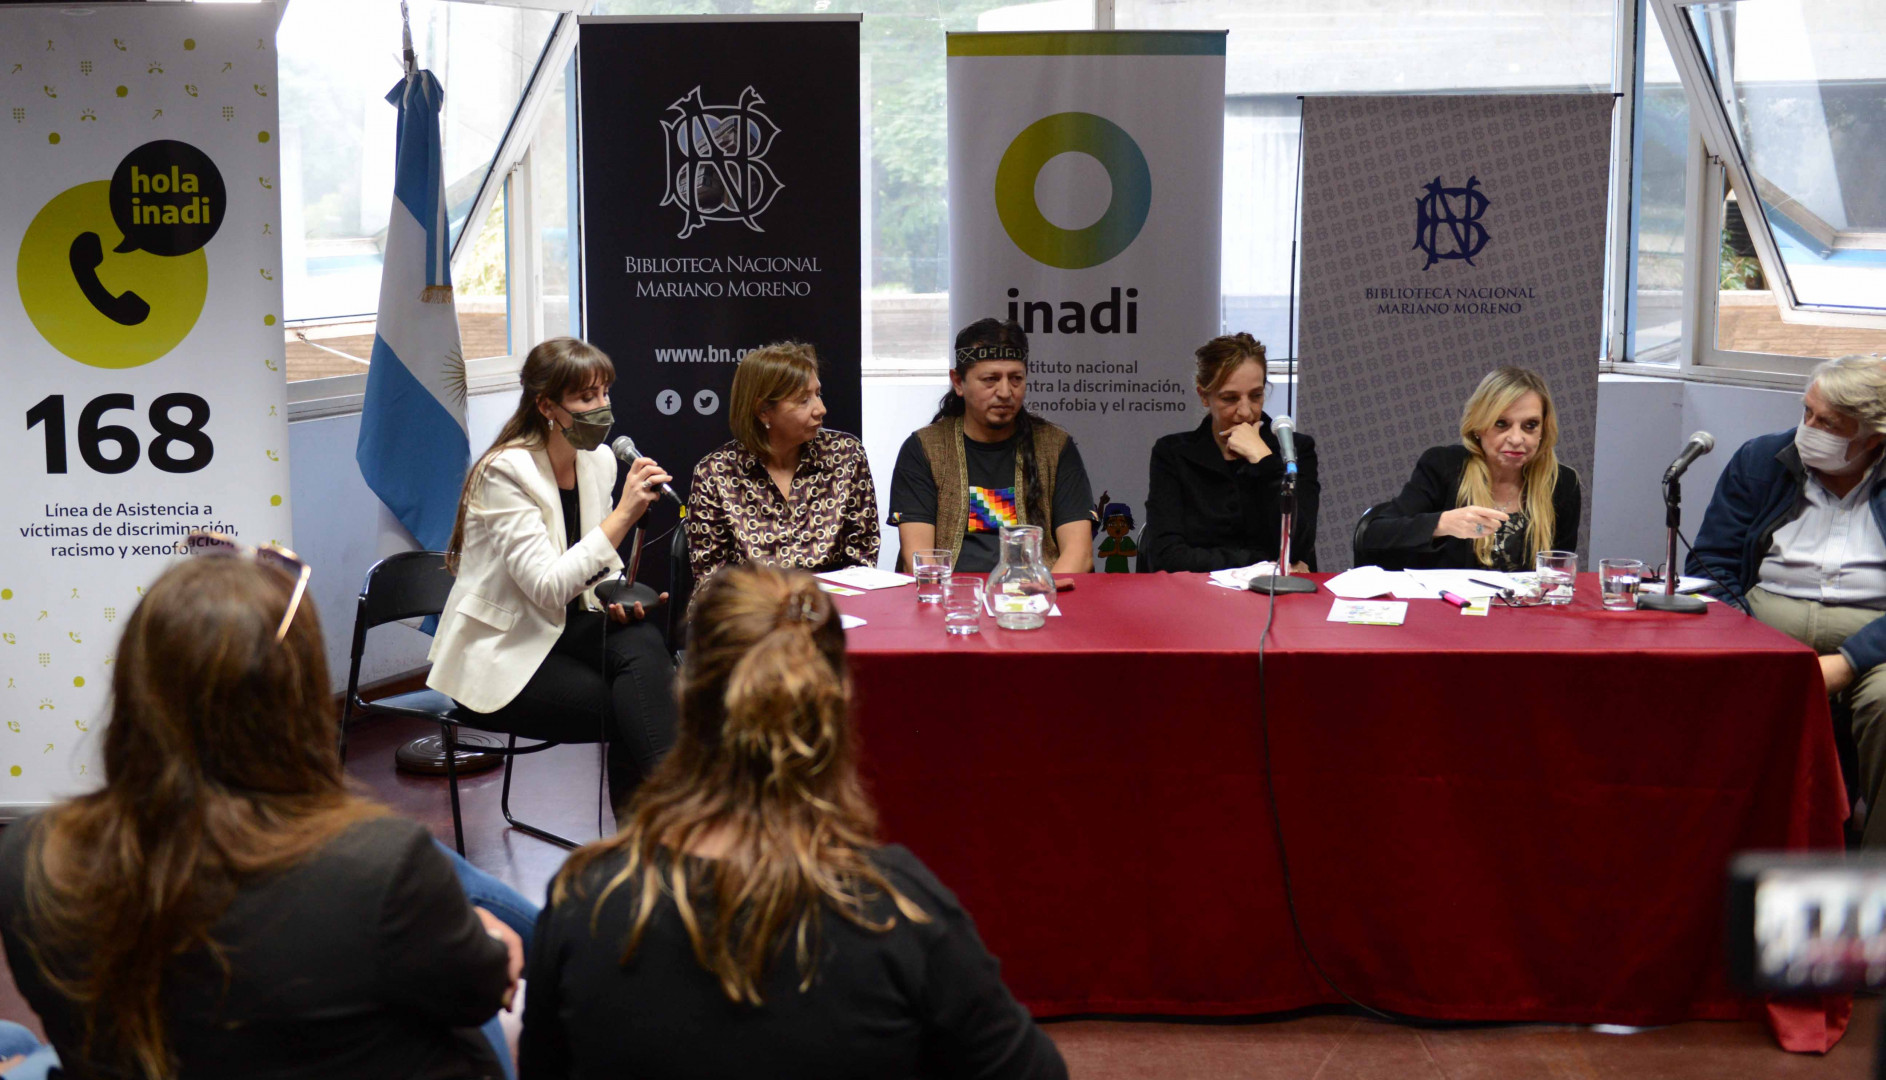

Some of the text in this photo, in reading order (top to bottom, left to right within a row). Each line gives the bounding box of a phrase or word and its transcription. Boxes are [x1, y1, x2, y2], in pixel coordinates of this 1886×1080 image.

[131, 165, 199, 193] hola
[132, 197, 210, 224] inadi
[1366, 287, 1536, 299] BIBLIOTECA NACIONAL
[1007, 286, 1138, 334] inadi
[1377, 302, 1522, 314] MARIANO MORENO
[1028, 360, 1138, 374] tituto nacional
[1026, 379, 1185, 395] ntra la discriminación,
[1100, 401, 1109, 415] y
[1112, 398, 1125, 412] el
[1128, 400, 1186, 412] racismo
[26, 392, 214, 474] 168
[45, 502, 213, 517] Línea de Asistencia a
[20, 521, 239, 537] víctimas de discriminación,
[51, 543, 115, 556] racismo
[118, 546, 128, 559] y
